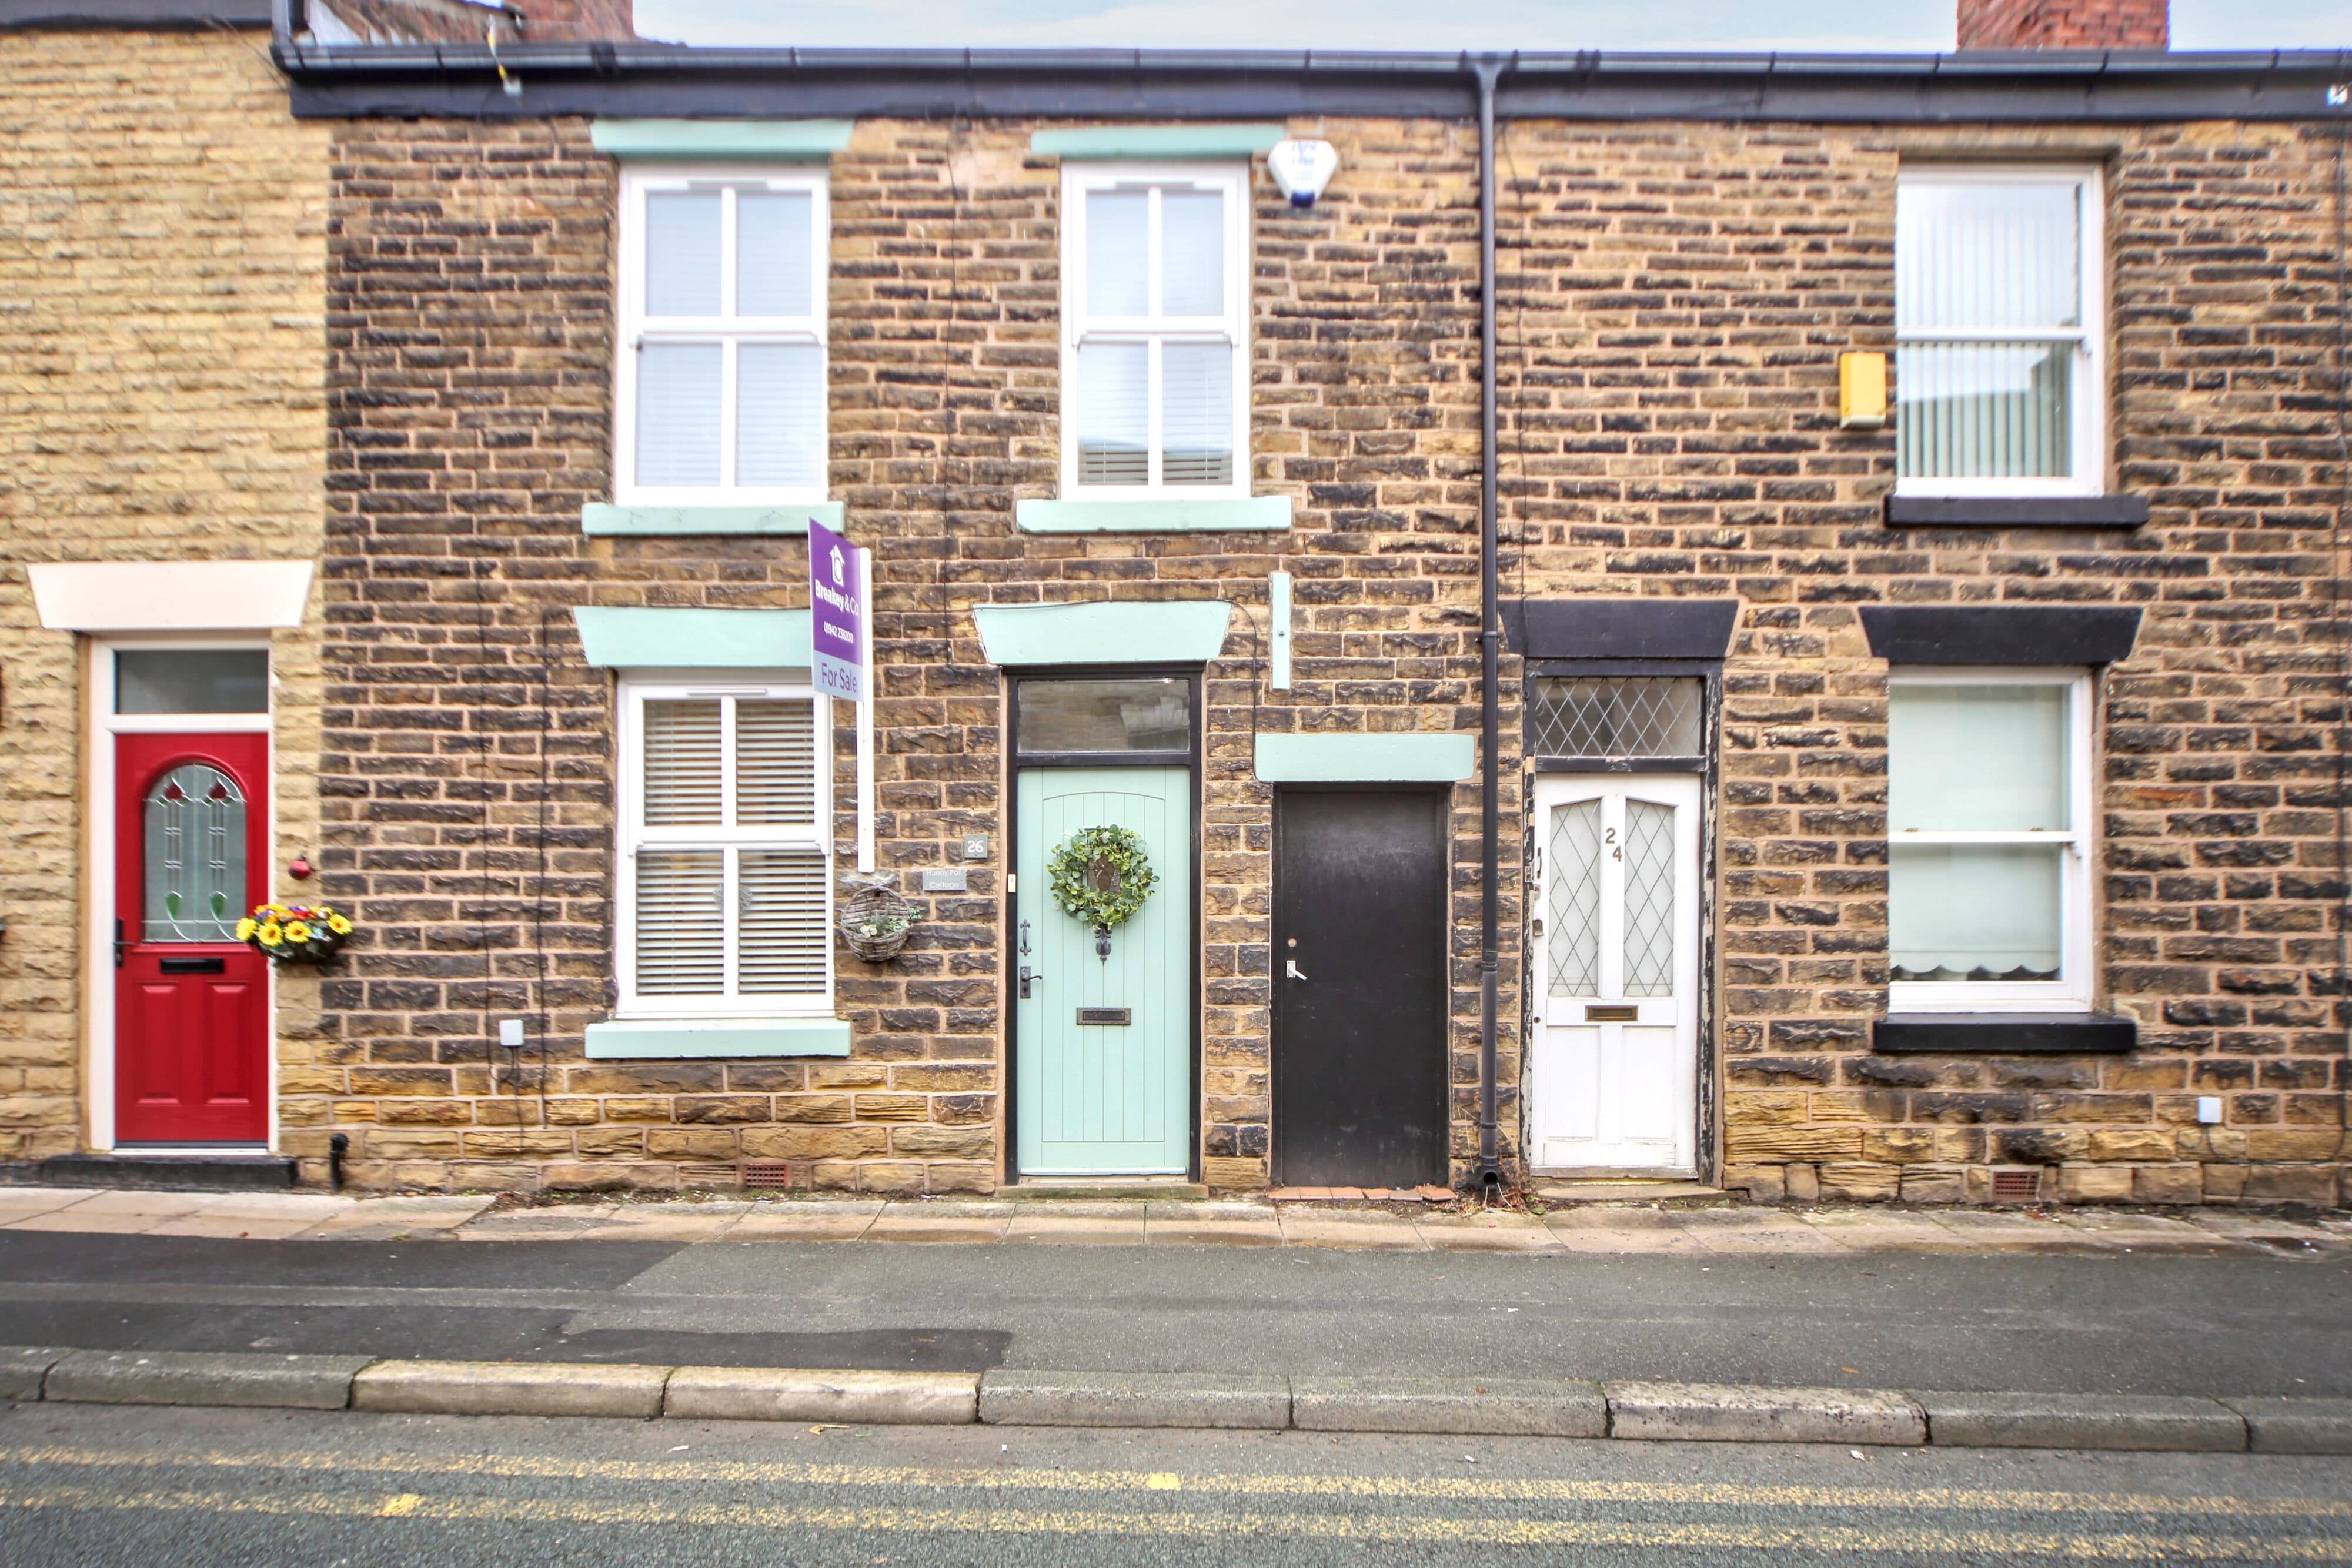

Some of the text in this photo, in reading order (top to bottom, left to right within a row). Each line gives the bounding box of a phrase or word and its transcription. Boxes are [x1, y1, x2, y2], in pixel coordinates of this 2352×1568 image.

[814, 579, 859, 616] Breakey & Co
[821, 662, 857, 693] For Sale
[967, 840, 984, 853] 26
